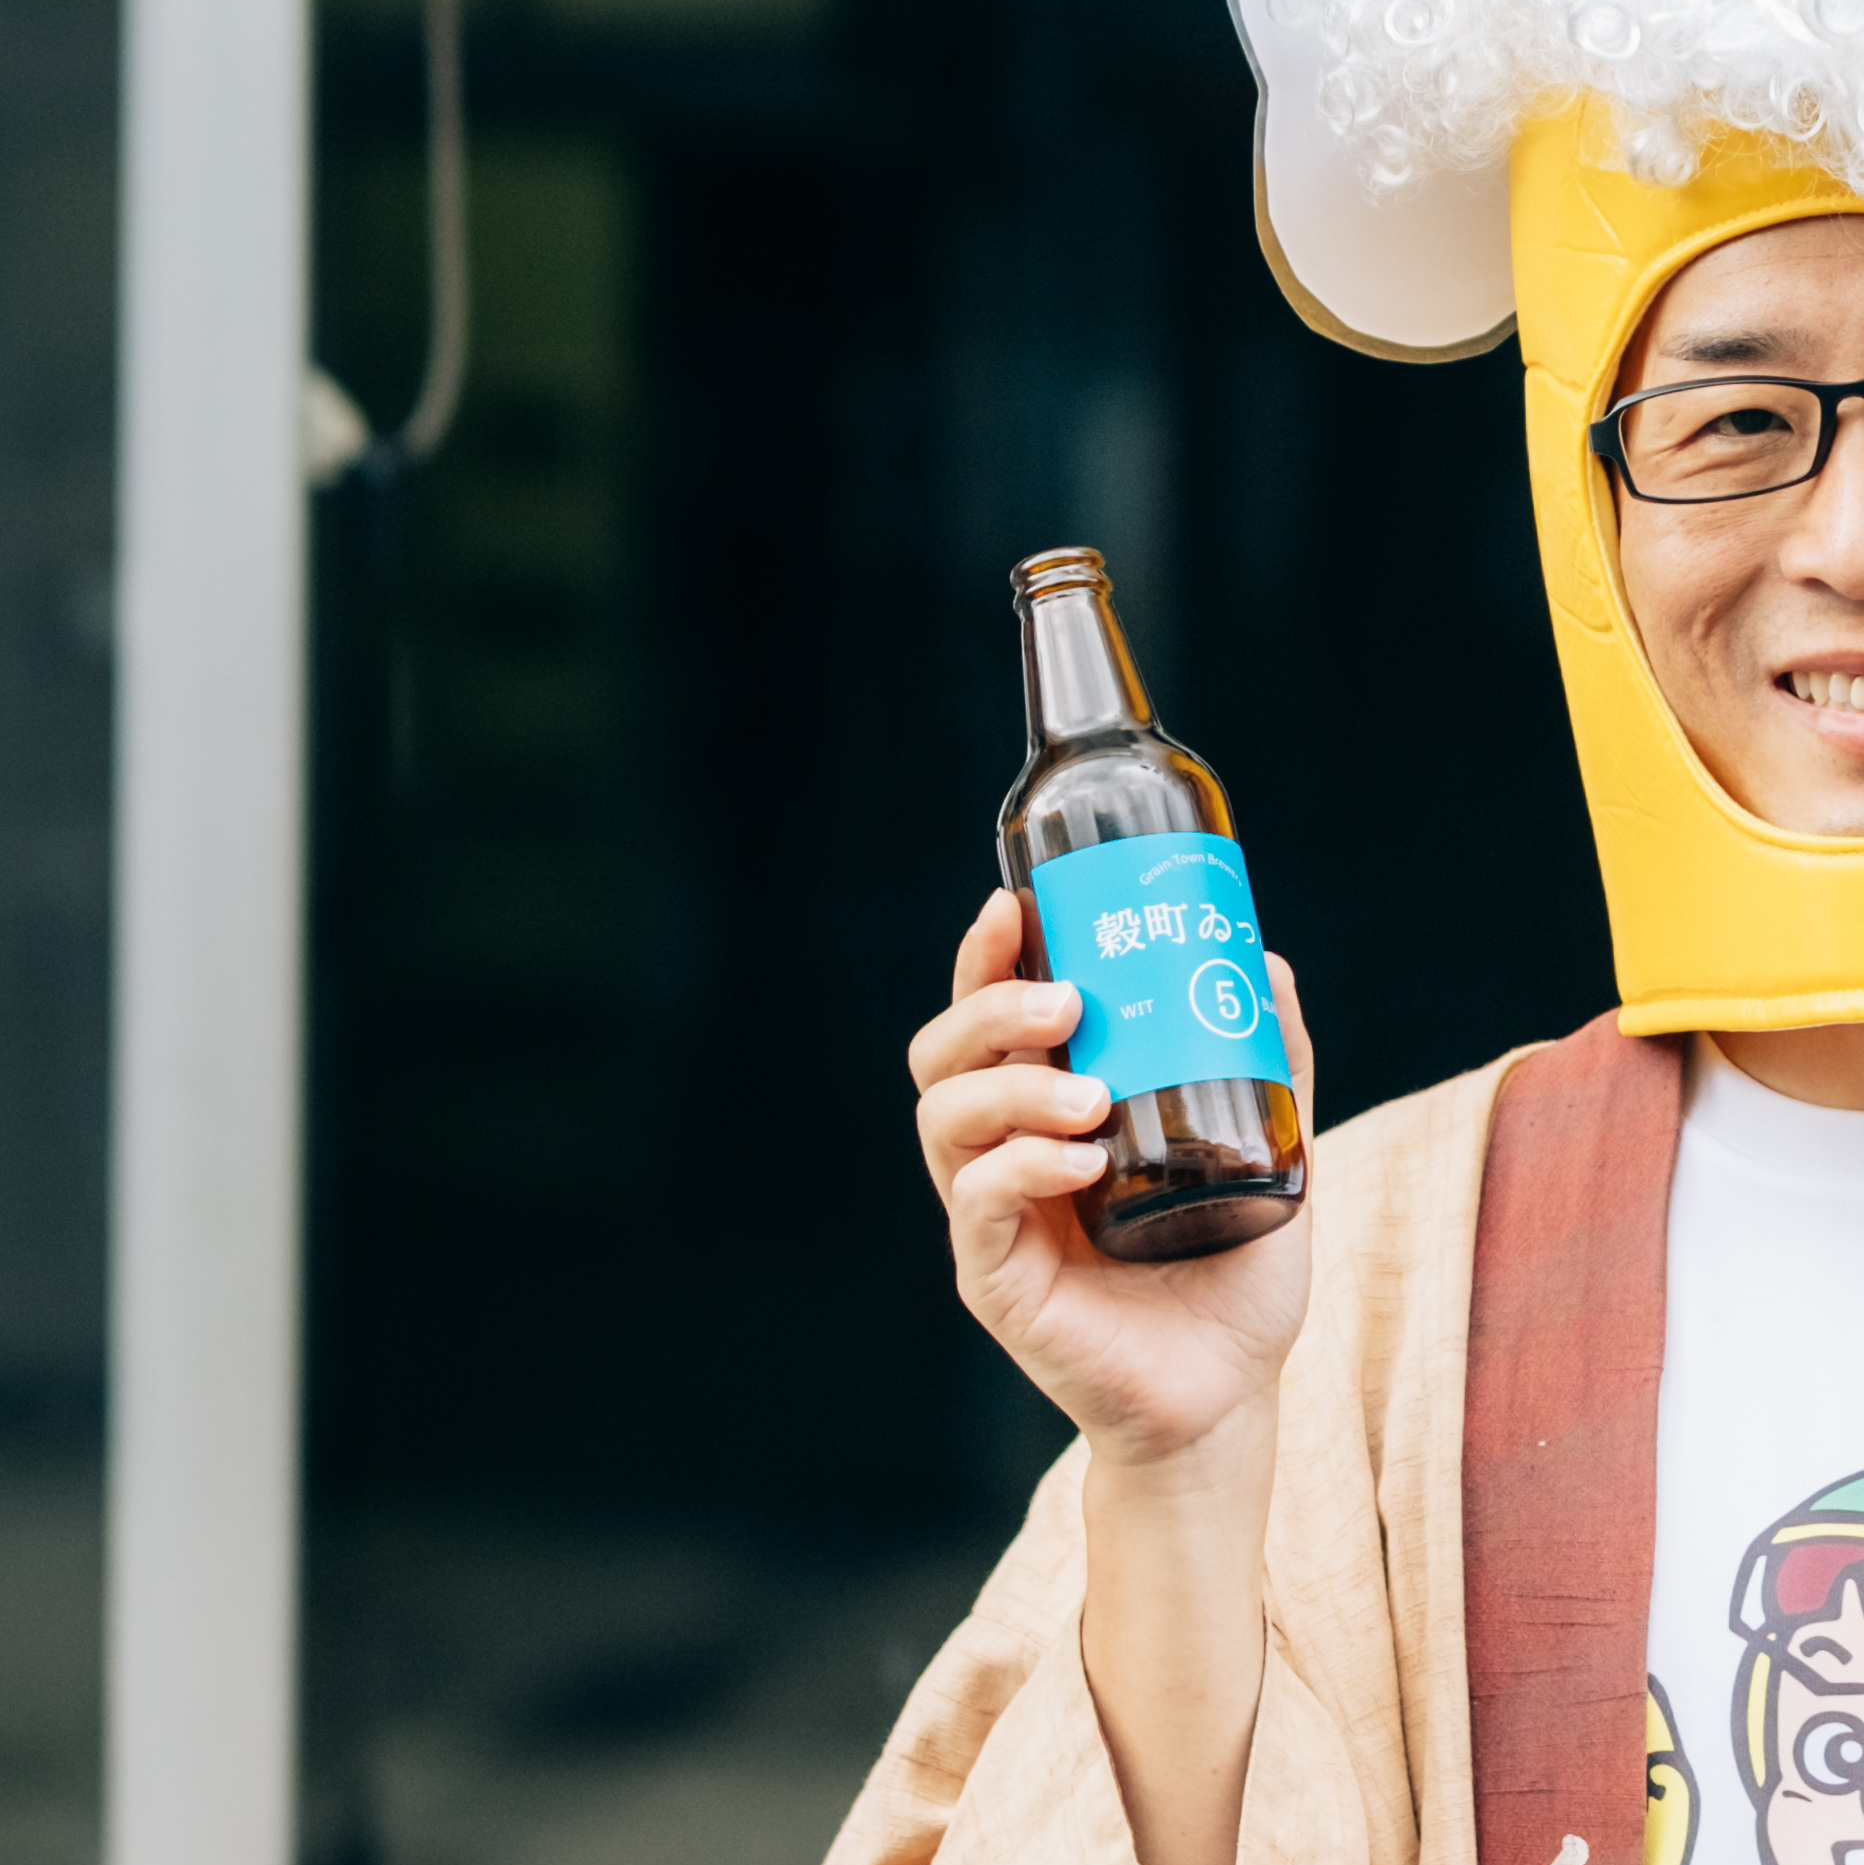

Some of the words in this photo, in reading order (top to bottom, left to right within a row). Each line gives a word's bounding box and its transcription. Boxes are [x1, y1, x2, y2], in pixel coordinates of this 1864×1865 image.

[1139, 859, 1172, 886] Grain
[1171, 853, 1206, 865] Town
[1119, 998, 1155, 1021] WIT
[1215, 979, 1242, 1021] 5
